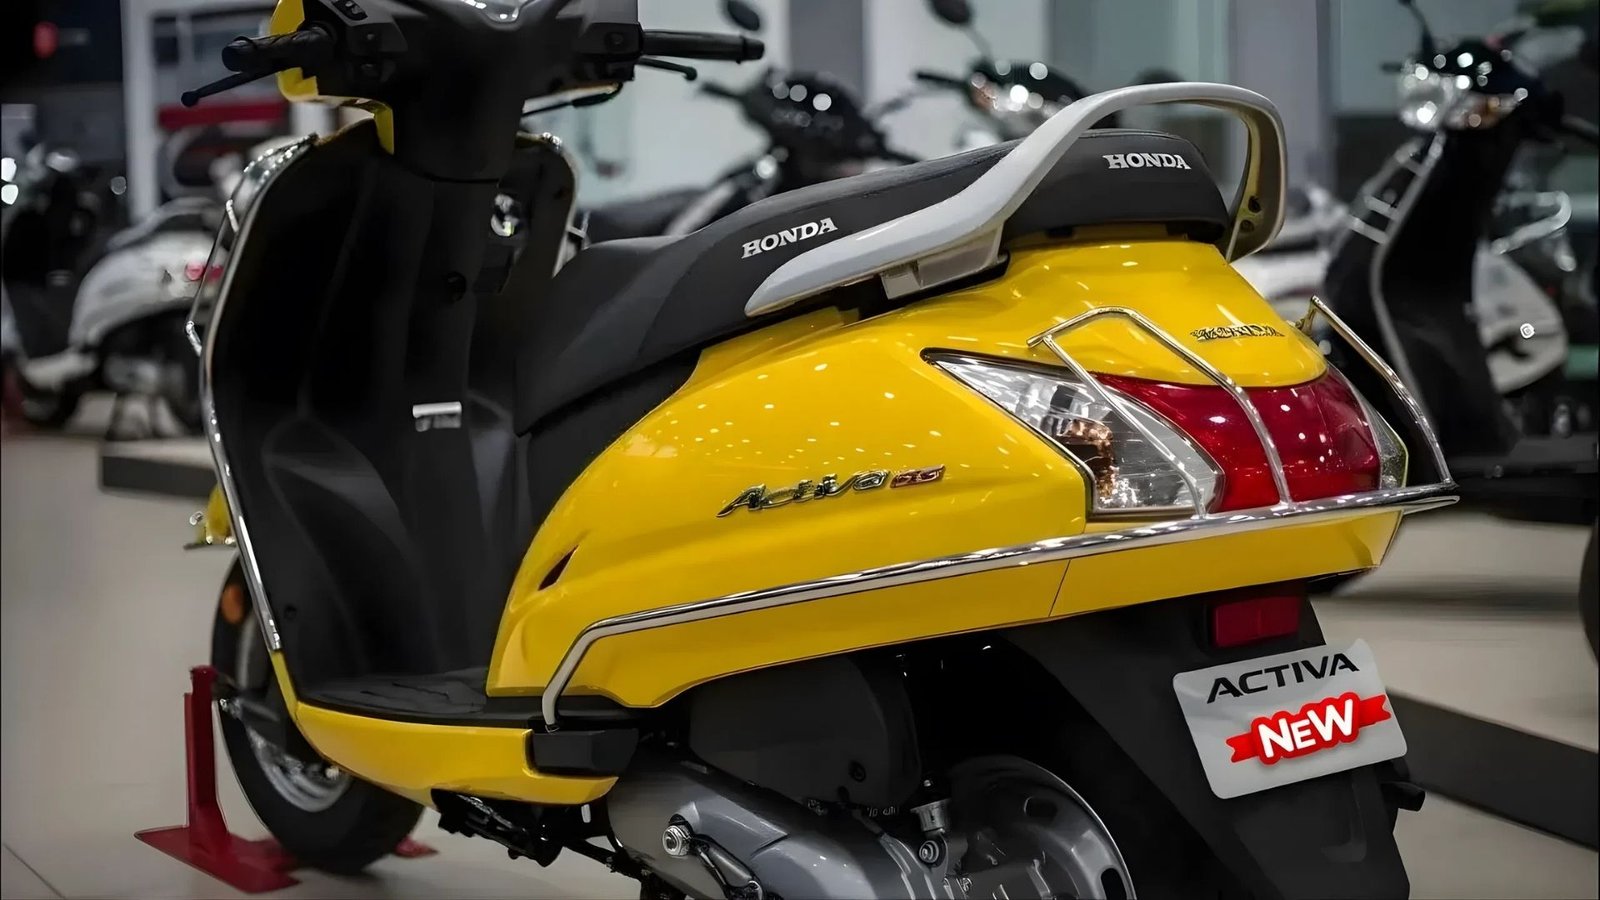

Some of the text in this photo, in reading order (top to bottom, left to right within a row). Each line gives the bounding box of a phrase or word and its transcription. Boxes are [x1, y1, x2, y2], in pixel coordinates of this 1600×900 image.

[1102, 153, 1192, 170] HONDA
[741, 217, 838, 259] HONDA
[1207, 653, 1360, 703] ACTIVA
